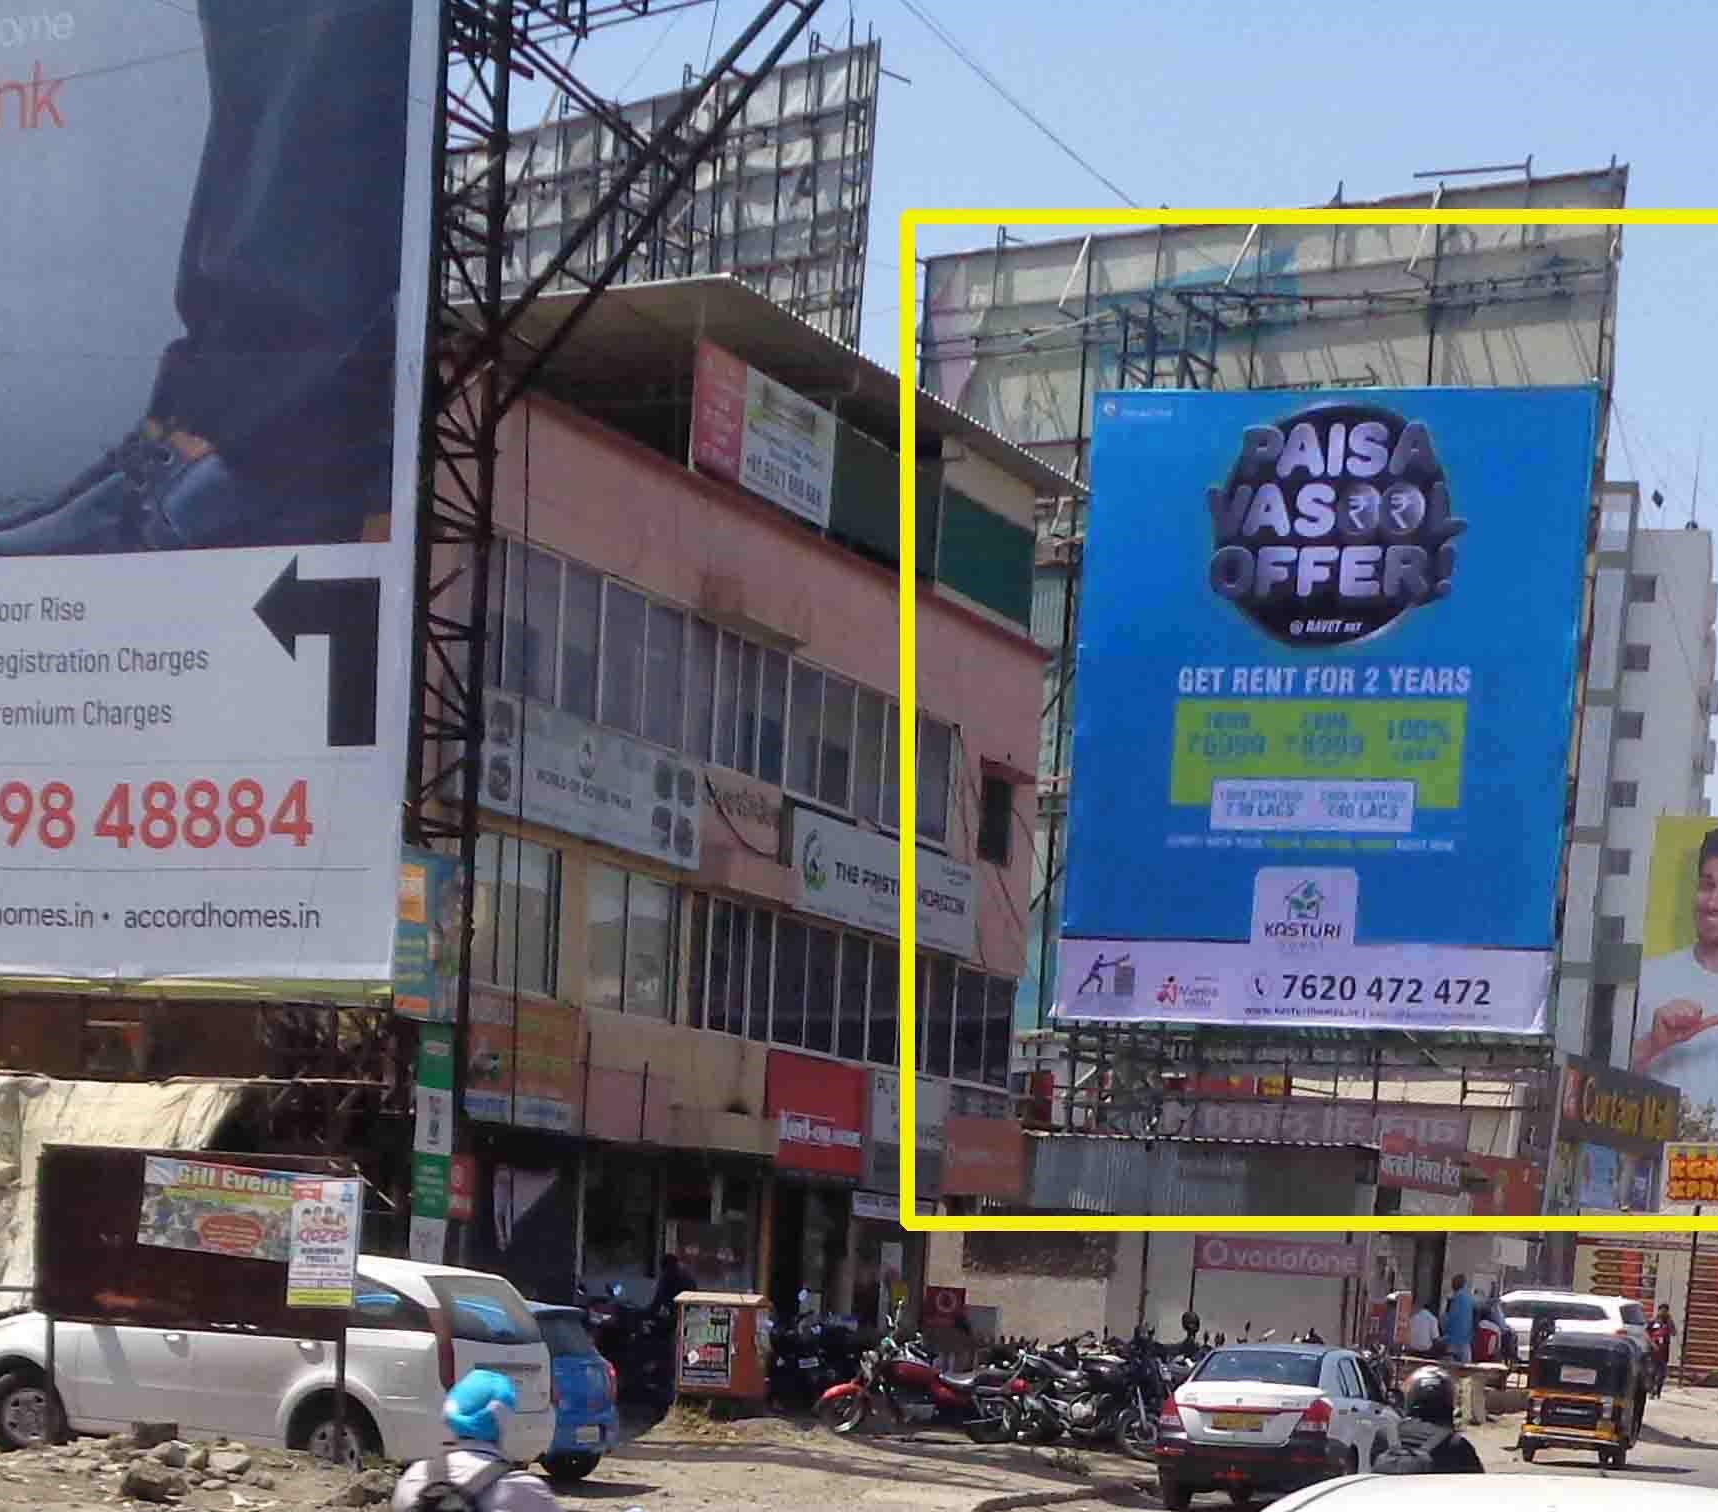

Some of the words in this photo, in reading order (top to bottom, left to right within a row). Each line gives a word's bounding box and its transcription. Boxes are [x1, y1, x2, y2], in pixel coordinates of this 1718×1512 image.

[1242, 420, 1435, 478] PAISA
[40, 595, 86, 622] Rise
[116, 644, 208, 679] Charges
[1178, 666, 1223, 693] GET
[1231, 666, 1298, 694] RENT
[1305, 667, 1354, 694] FOR
[1363, 667, 1380, 694] 2
[1388, 666, 1471, 695] YEARS
[82, 698, 172, 732] Charges
[93, 779, 314, 848] 48884
[123, 901, 320, 931] accordhomes.in
[1263, 921, 1343, 938] KASTURI
[1283, 973, 1356, 1001] 7620
[1366, 974, 1421, 1003] 472
[1434, 976, 1491, 1006] 472
[1233, 1247, 1357, 1273] vodafone
